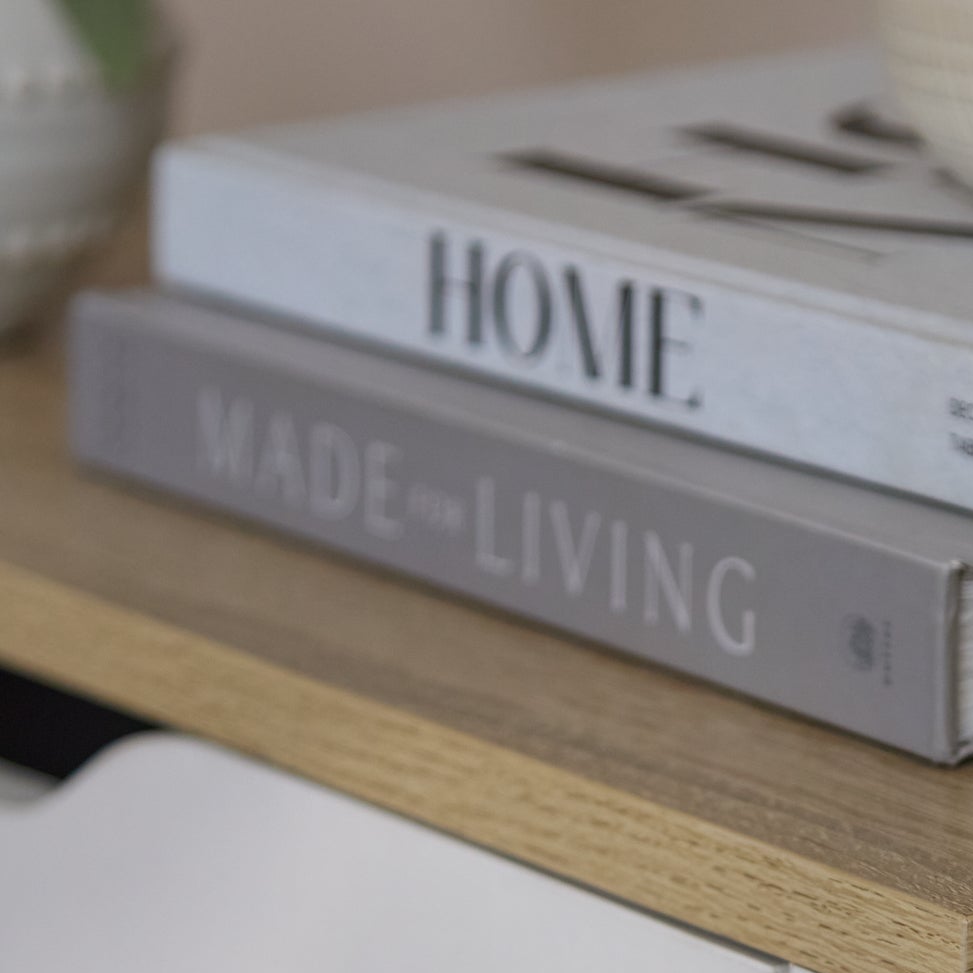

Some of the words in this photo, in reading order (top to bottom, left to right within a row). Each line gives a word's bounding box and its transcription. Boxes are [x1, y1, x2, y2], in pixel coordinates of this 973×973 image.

[424, 228, 704, 410] HOME
[196, 387, 404, 540] MADE
[474, 475, 760, 657] LIVING
